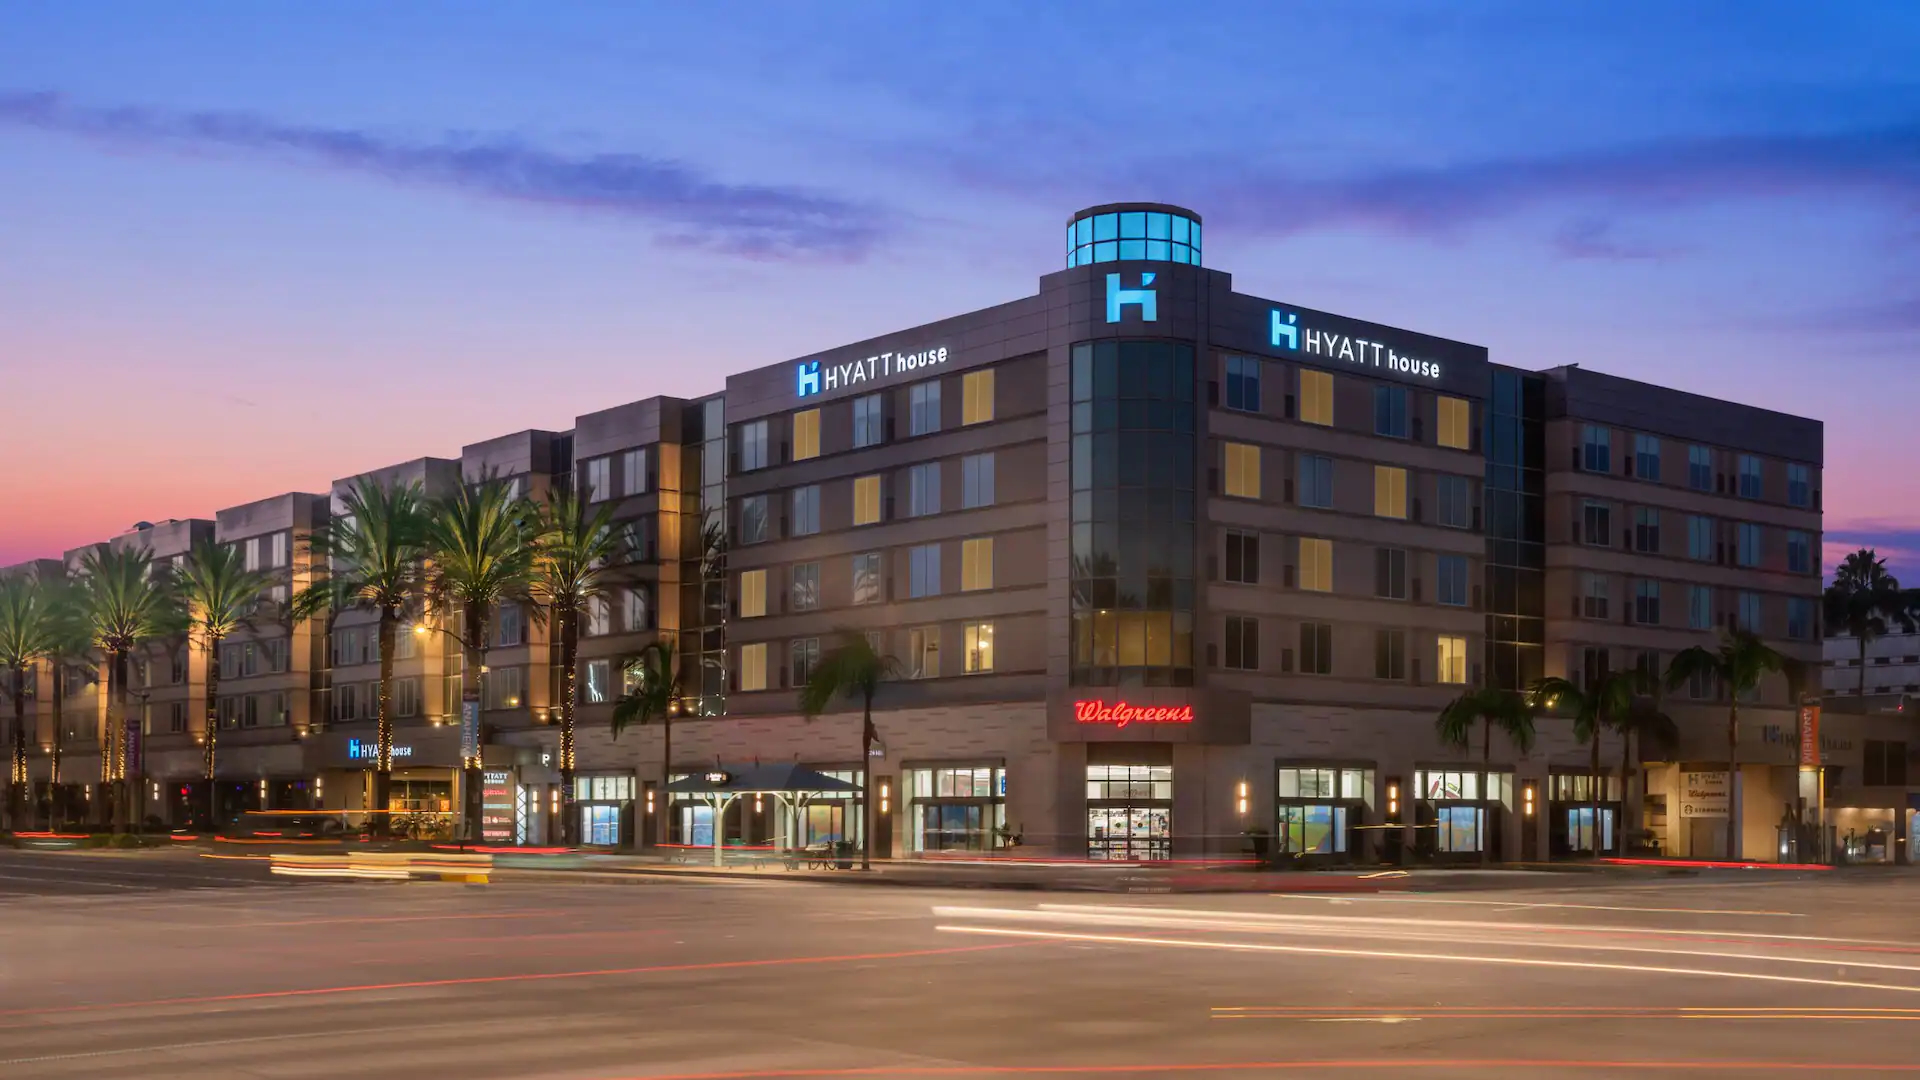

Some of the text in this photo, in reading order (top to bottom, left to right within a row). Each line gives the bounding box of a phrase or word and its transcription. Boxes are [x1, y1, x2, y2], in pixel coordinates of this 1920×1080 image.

[825, 352, 893, 390] HYATT
[896, 347, 948, 373] house
[1305, 328, 1384, 367] HYATT
[1388, 349, 1440, 378] house
[1075, 700, 1193, 728] Walgreens
[1803, 707, 1813, 763] ANAHEIM
[361, 744, 379, 758] HYA
[391, 745, 412, 757] house
